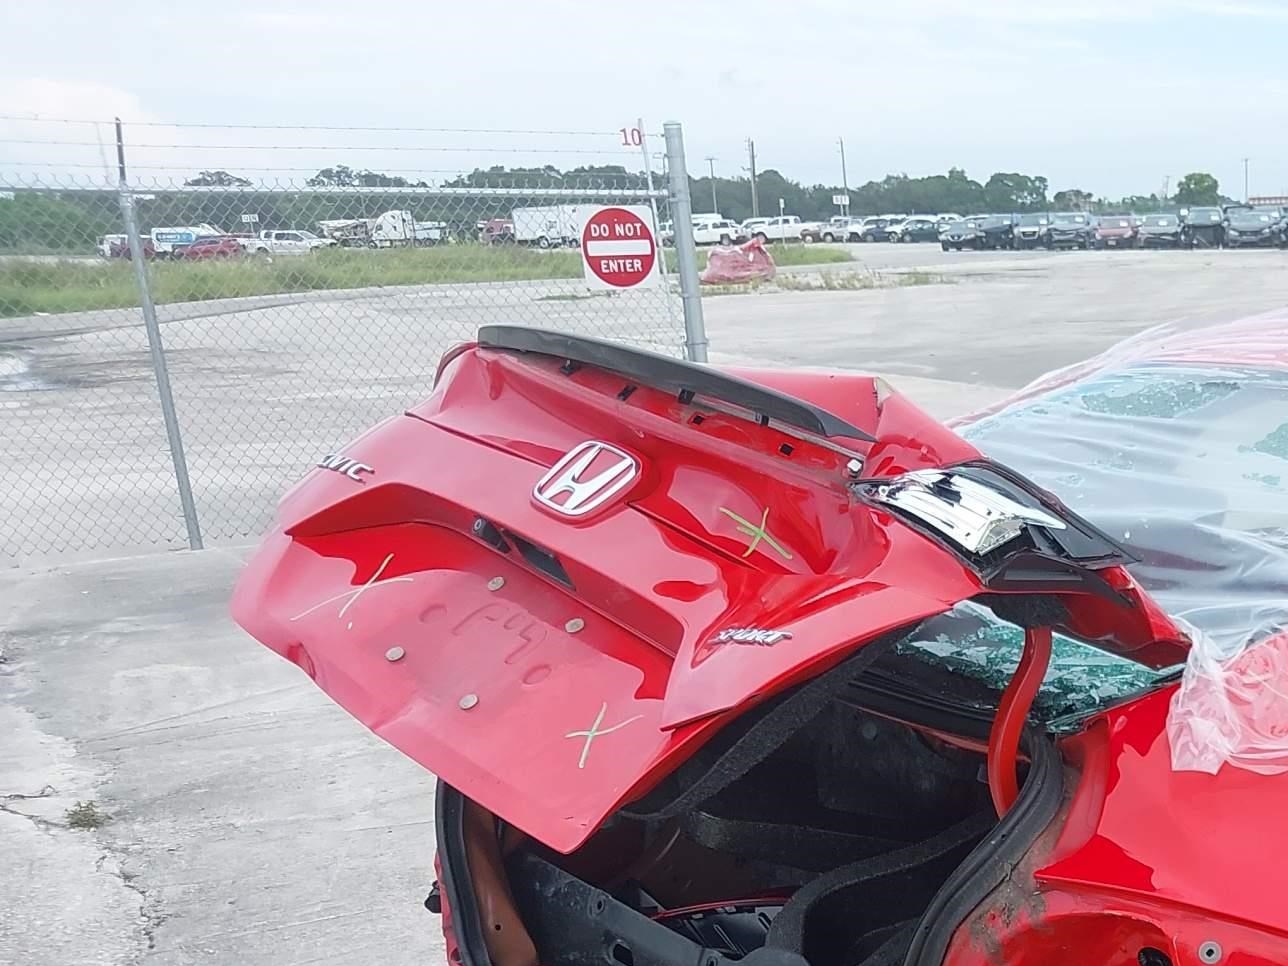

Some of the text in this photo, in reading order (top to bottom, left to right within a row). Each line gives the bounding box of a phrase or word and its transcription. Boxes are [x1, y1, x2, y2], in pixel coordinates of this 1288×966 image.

[619, 127, 643, 146] 10
[590, 222, 642, 237] DO NOT
[600, 258, 642, 273] ENTER
